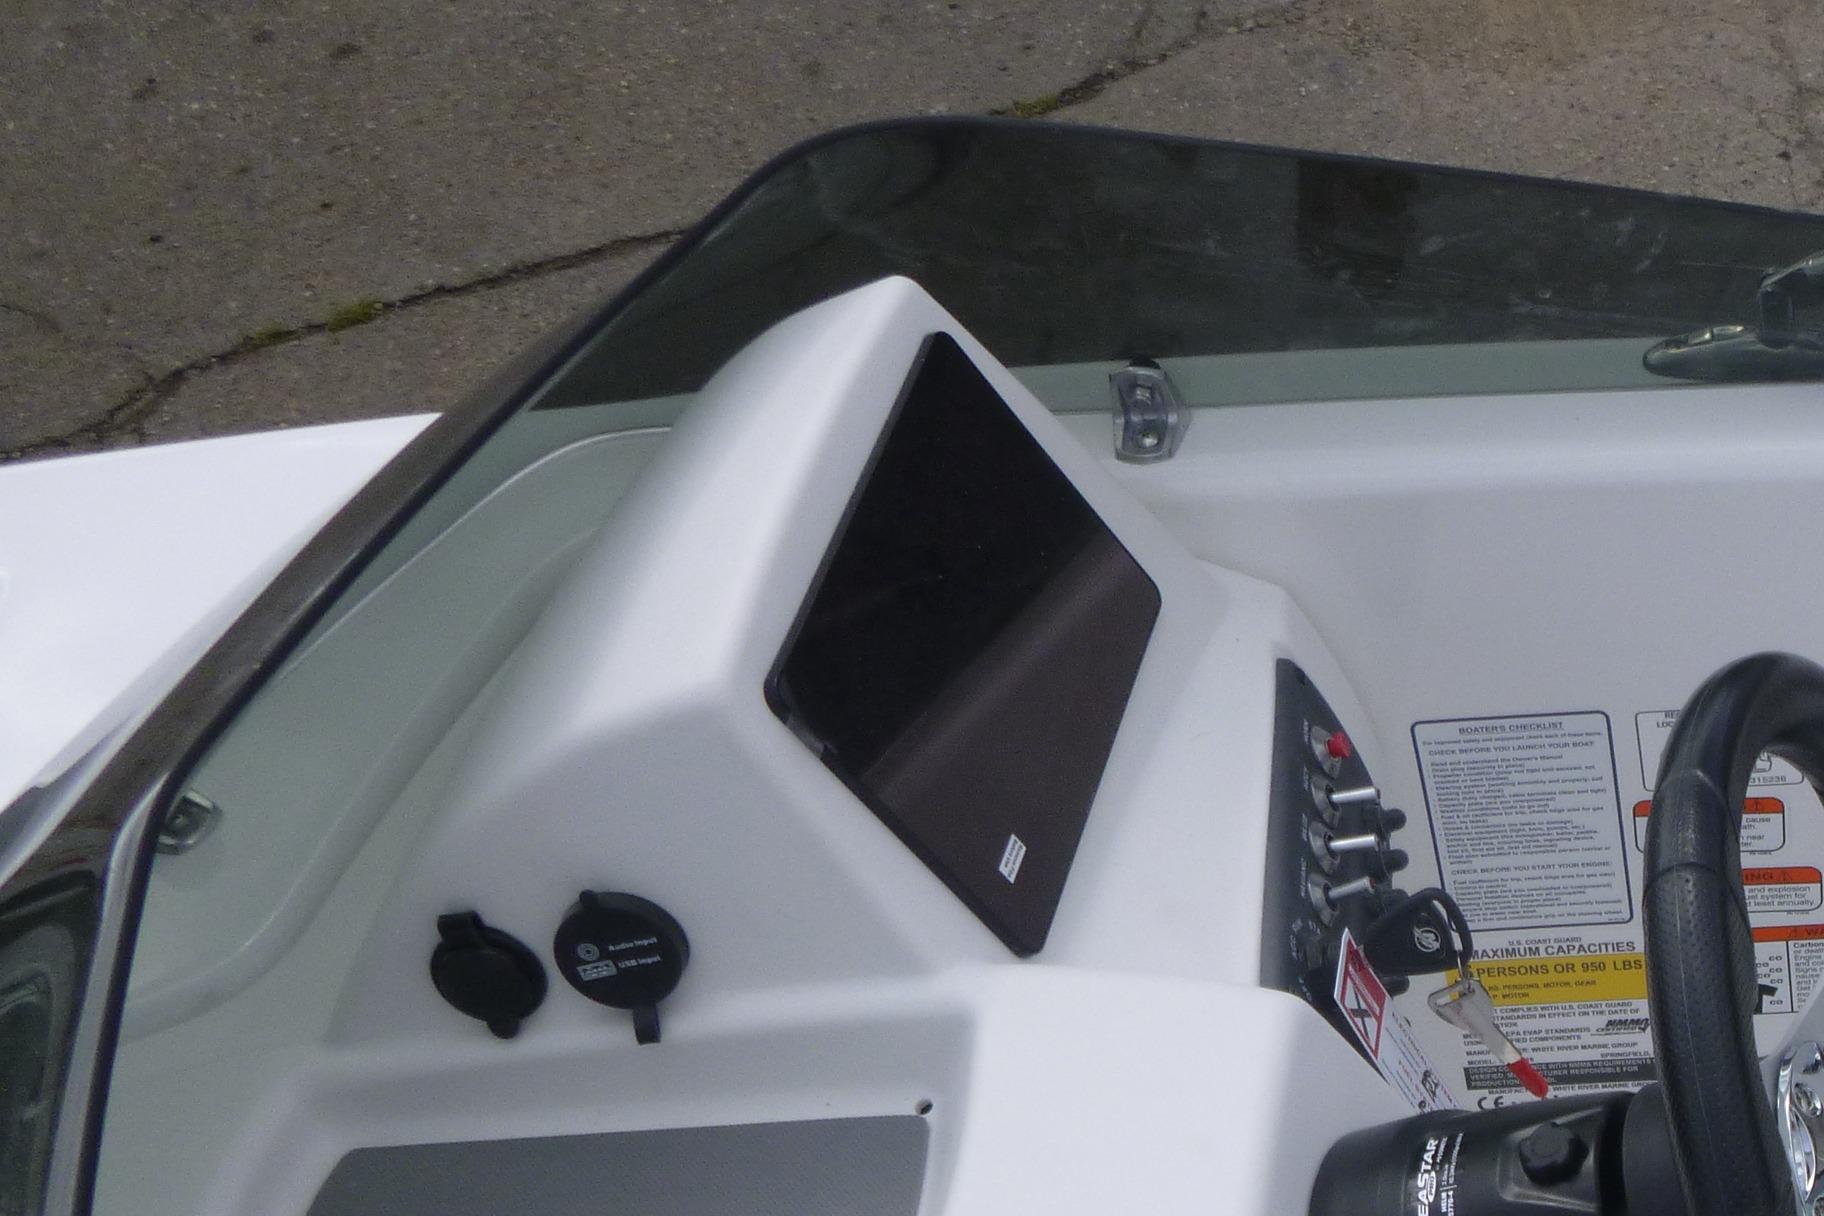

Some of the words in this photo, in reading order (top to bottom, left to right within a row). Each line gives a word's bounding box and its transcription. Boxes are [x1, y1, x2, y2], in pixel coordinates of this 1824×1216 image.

[1508, 721, 1564, 732] CHECKLIST
[1469, 947, 1541, 960] MAXIMUM
[1544, 941, 1637, 957] CAPACITIES
[1476, 964, 1550, 979] PERSONS
[1553, 963, 1577, 974] OR
[1581, 961, 1607, 973] 950
[1612, 959, 1644, 971] LBS
